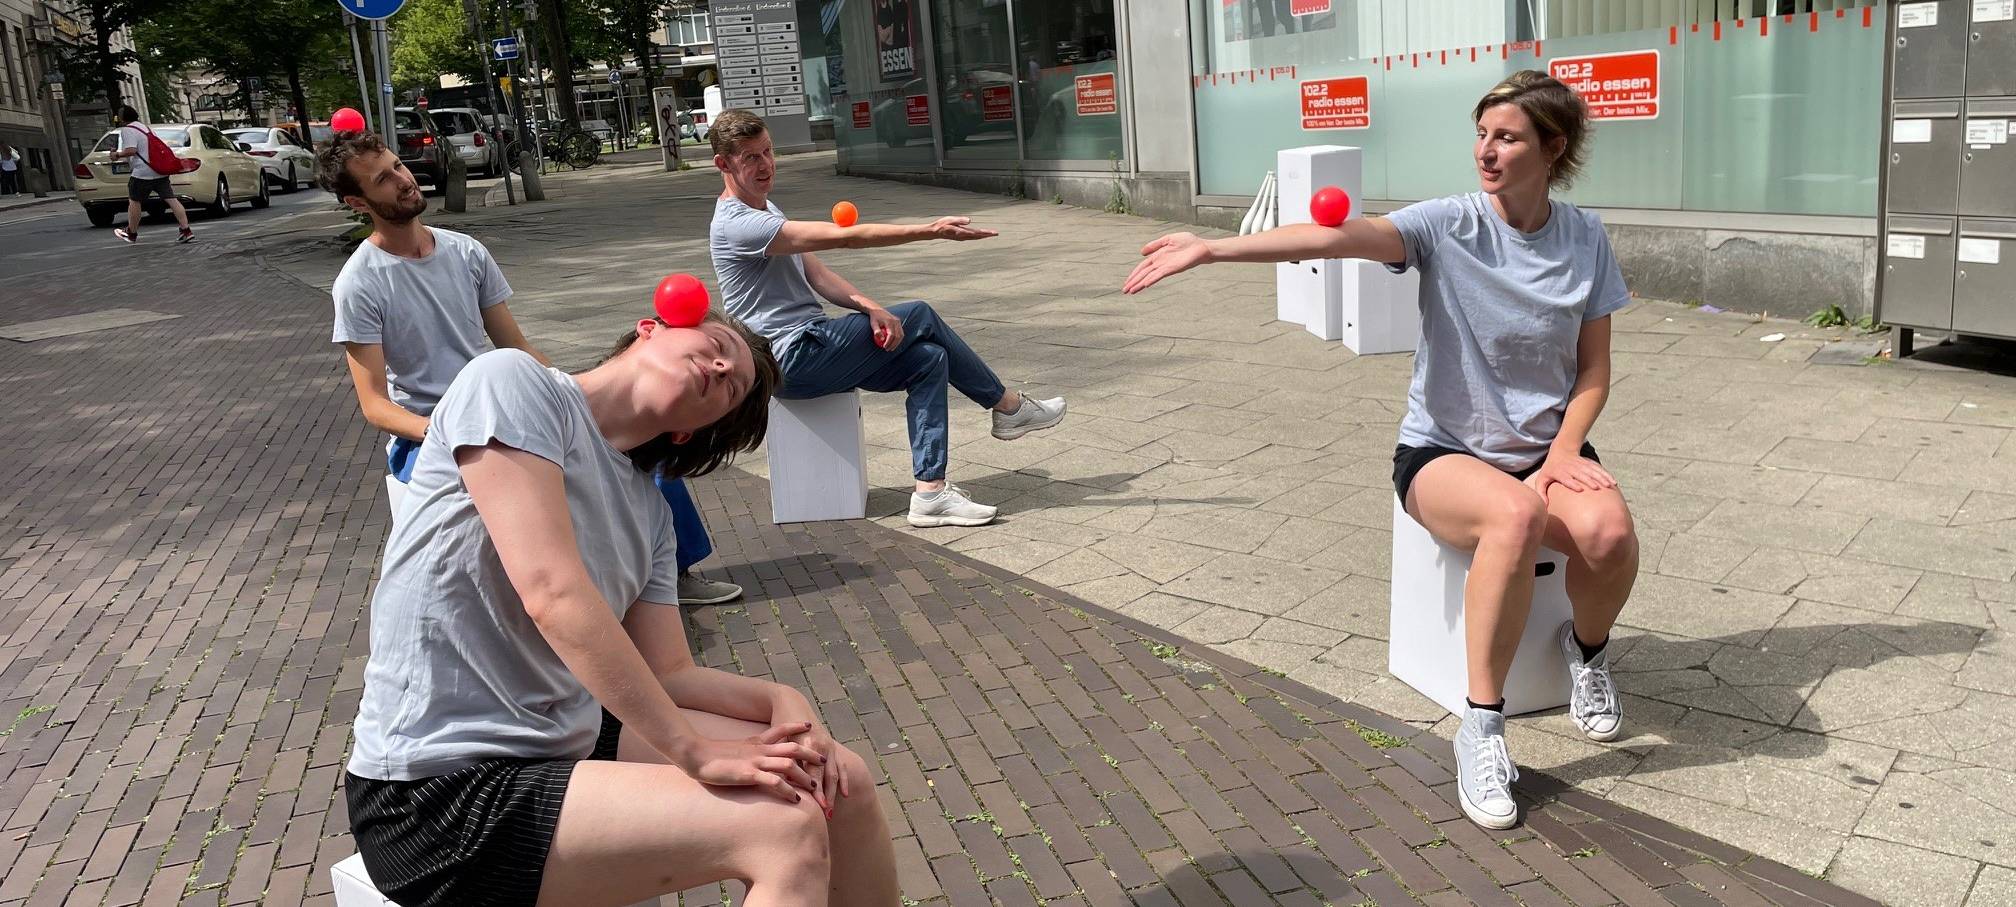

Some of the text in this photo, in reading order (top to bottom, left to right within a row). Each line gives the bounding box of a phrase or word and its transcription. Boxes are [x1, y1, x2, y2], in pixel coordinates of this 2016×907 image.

[881, 46, 913, 72] ESSEN
[1554, 62, 1593, 79] 102.2
[1303, 84, 1328, 96] 102.2
[1568, 77, 1650, 93] adio essen
[1308, 96, 1364, 108] radio essen
